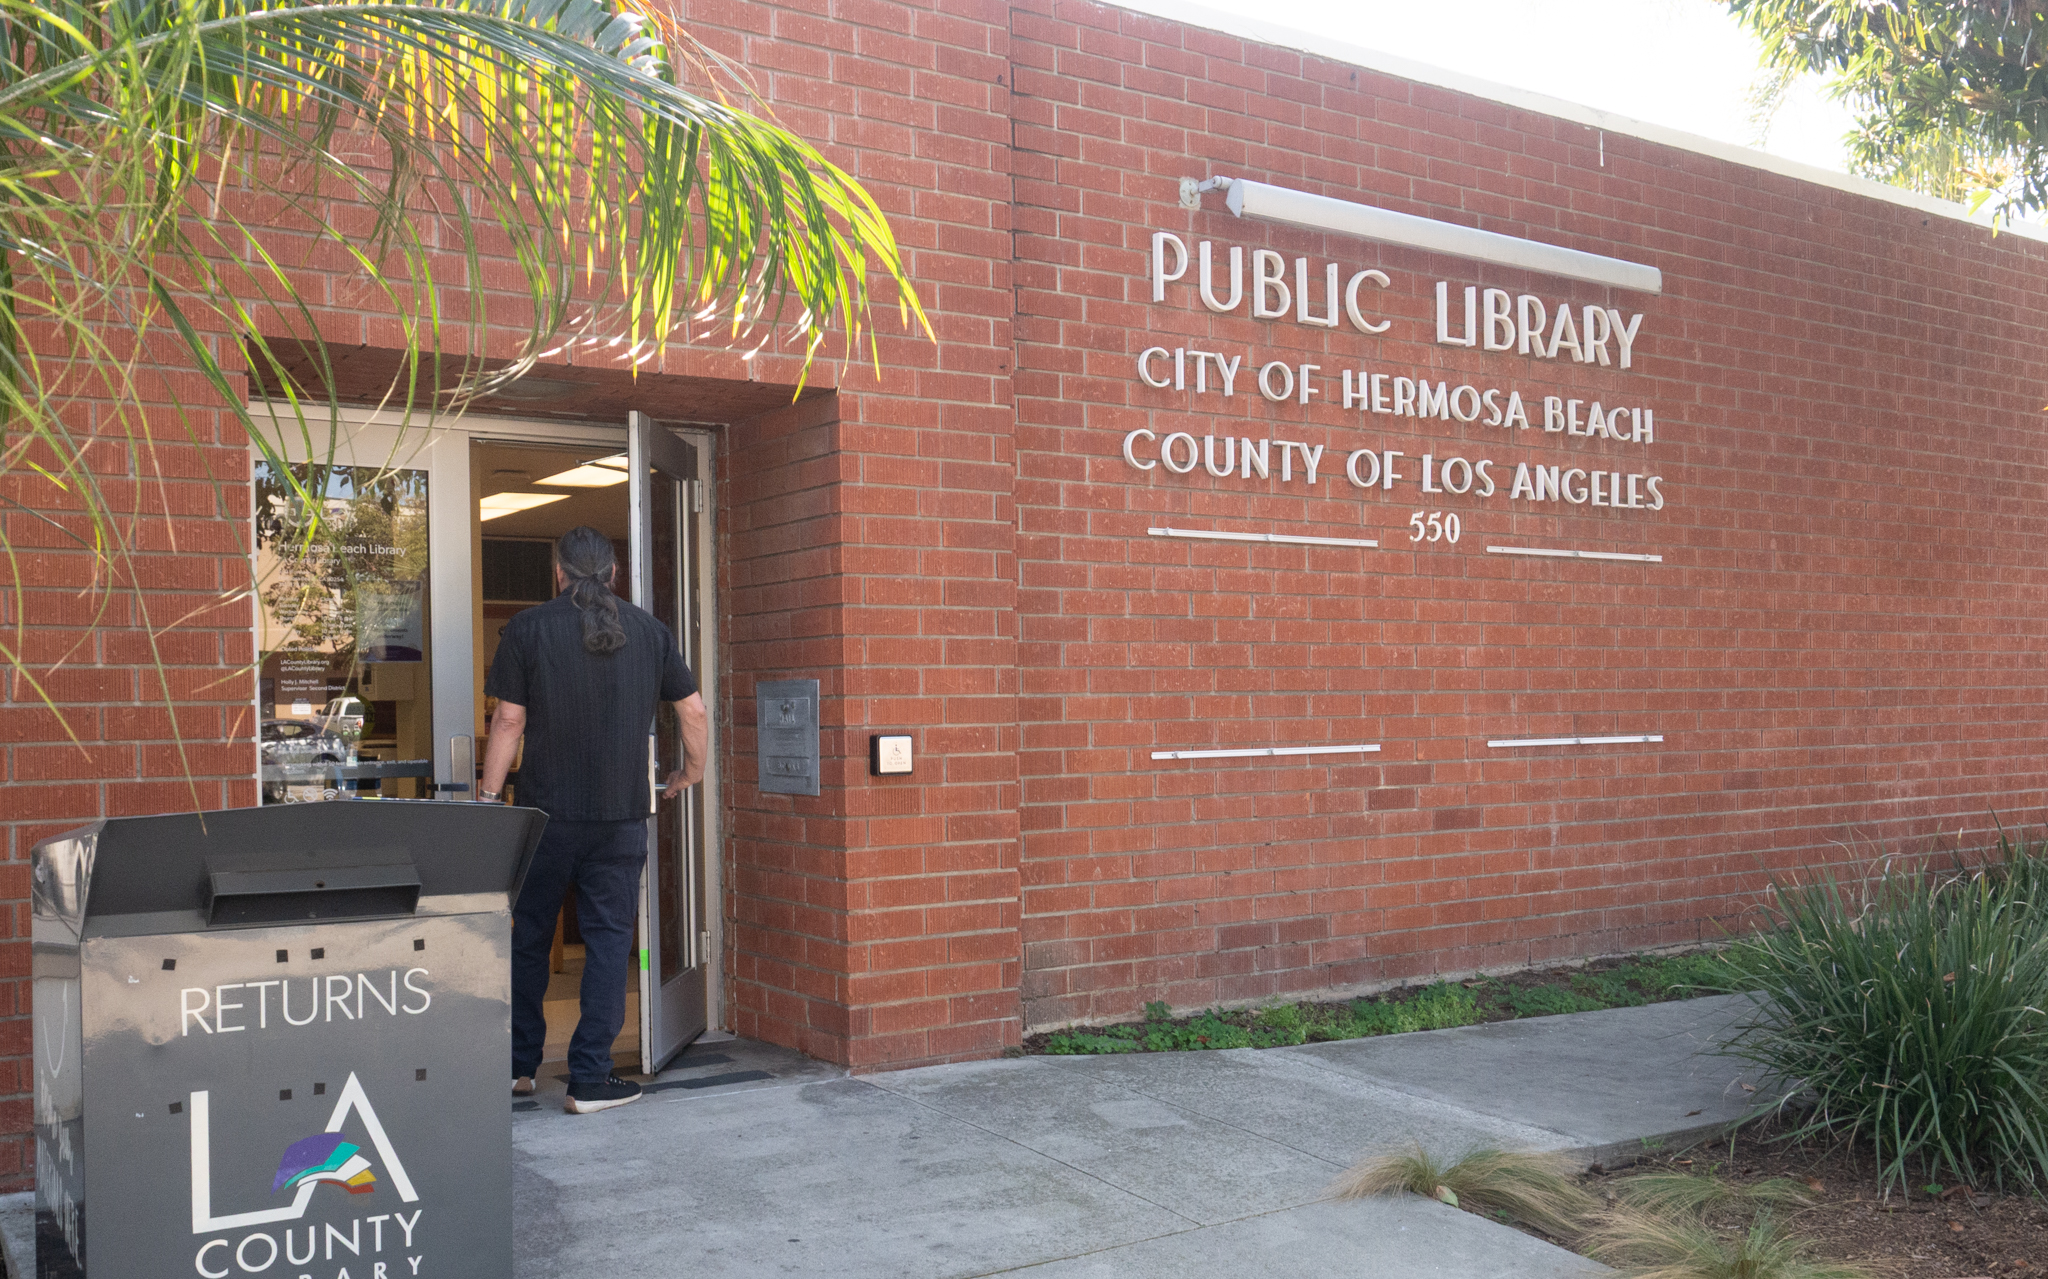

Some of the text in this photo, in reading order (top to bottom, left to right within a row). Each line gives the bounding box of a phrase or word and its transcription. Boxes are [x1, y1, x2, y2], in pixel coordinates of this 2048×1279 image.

[1152, 232, 1643, 369] PUBLIC LIBRARY
[1137, 346, 1653, 443] CITY OF HERMOSA BEACH
[1123, 428, 1664, 510] COUNTY OF LOS ANGELES
[369, 544, 407, 557] Library
[1409, 511, 1461, 543] 550
[180, 967, 432, 1037] RETURNS
[190, 1070, 420, 1234] LA
[195, 1209, 423, 1279] COUNTY
[298, 1255, 423, 1279] ARY
